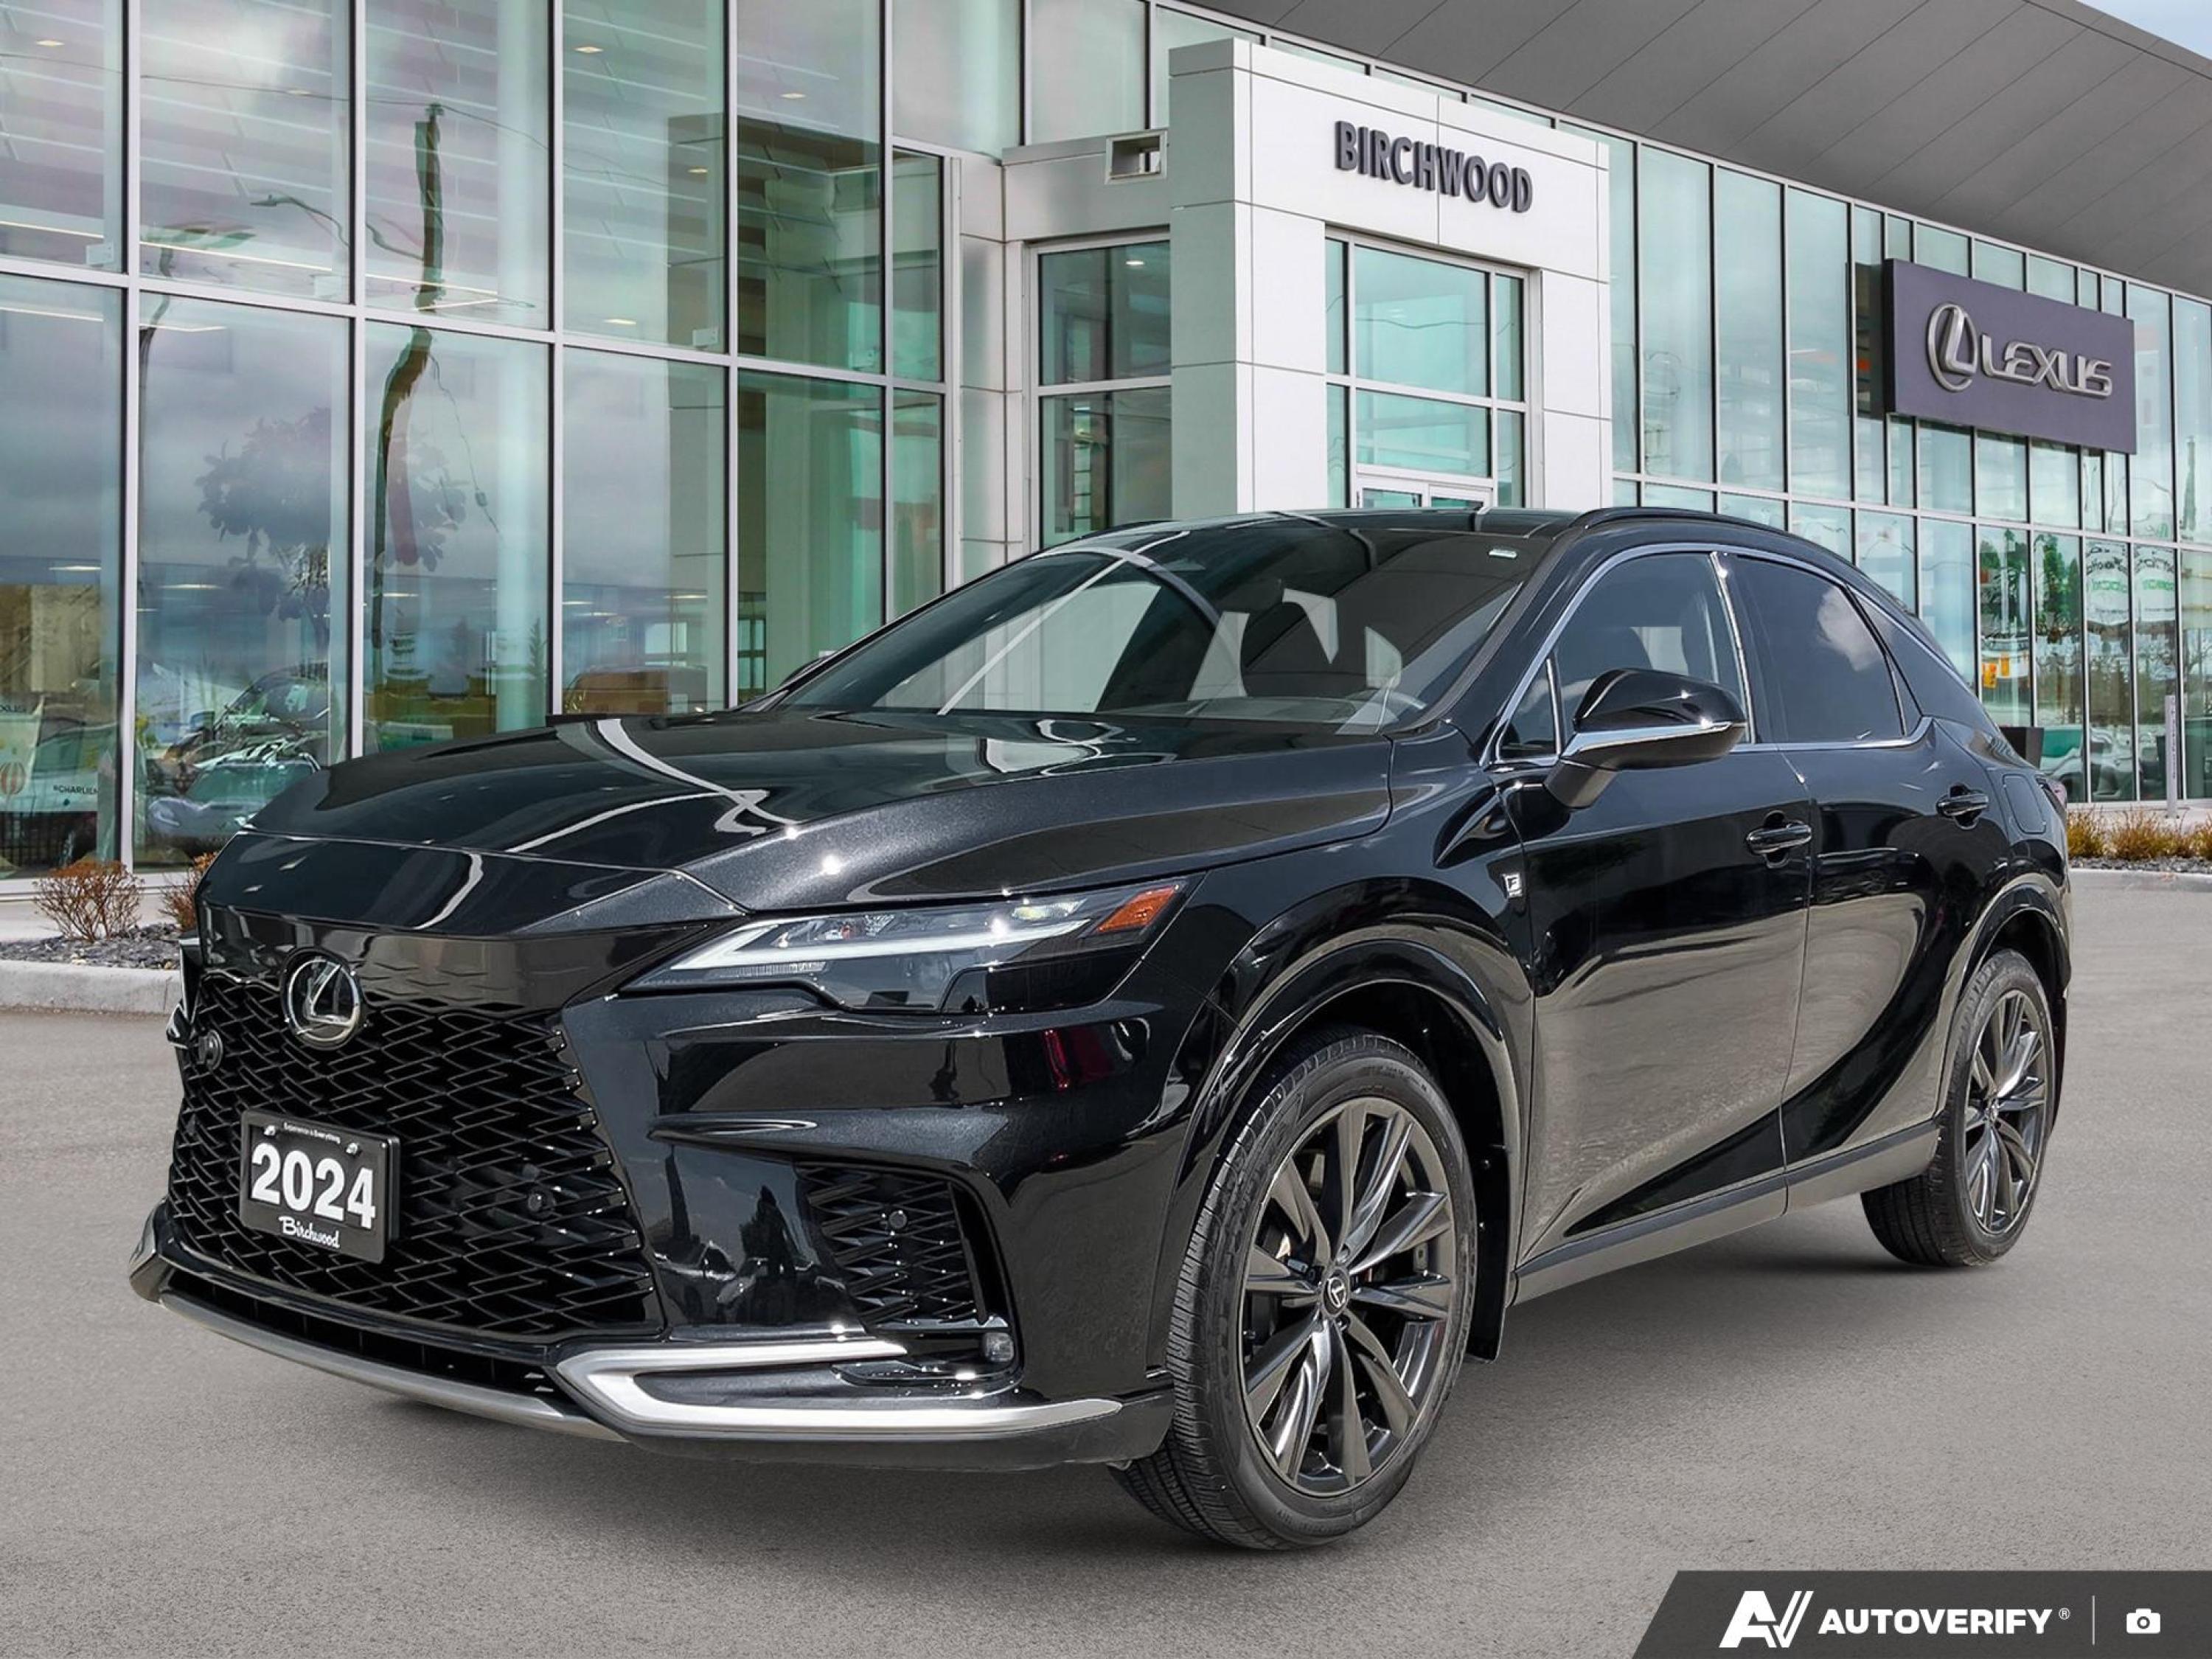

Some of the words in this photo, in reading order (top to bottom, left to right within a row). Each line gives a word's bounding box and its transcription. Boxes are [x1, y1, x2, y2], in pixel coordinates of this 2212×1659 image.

[1335, 120, 1533, 213] BIRCHWOOD
[1982, 334, 2113, 399] LEXUS
[251, 1142, 376, 1229] 2024
[278, 1216, 341, 1248] Birchwood
